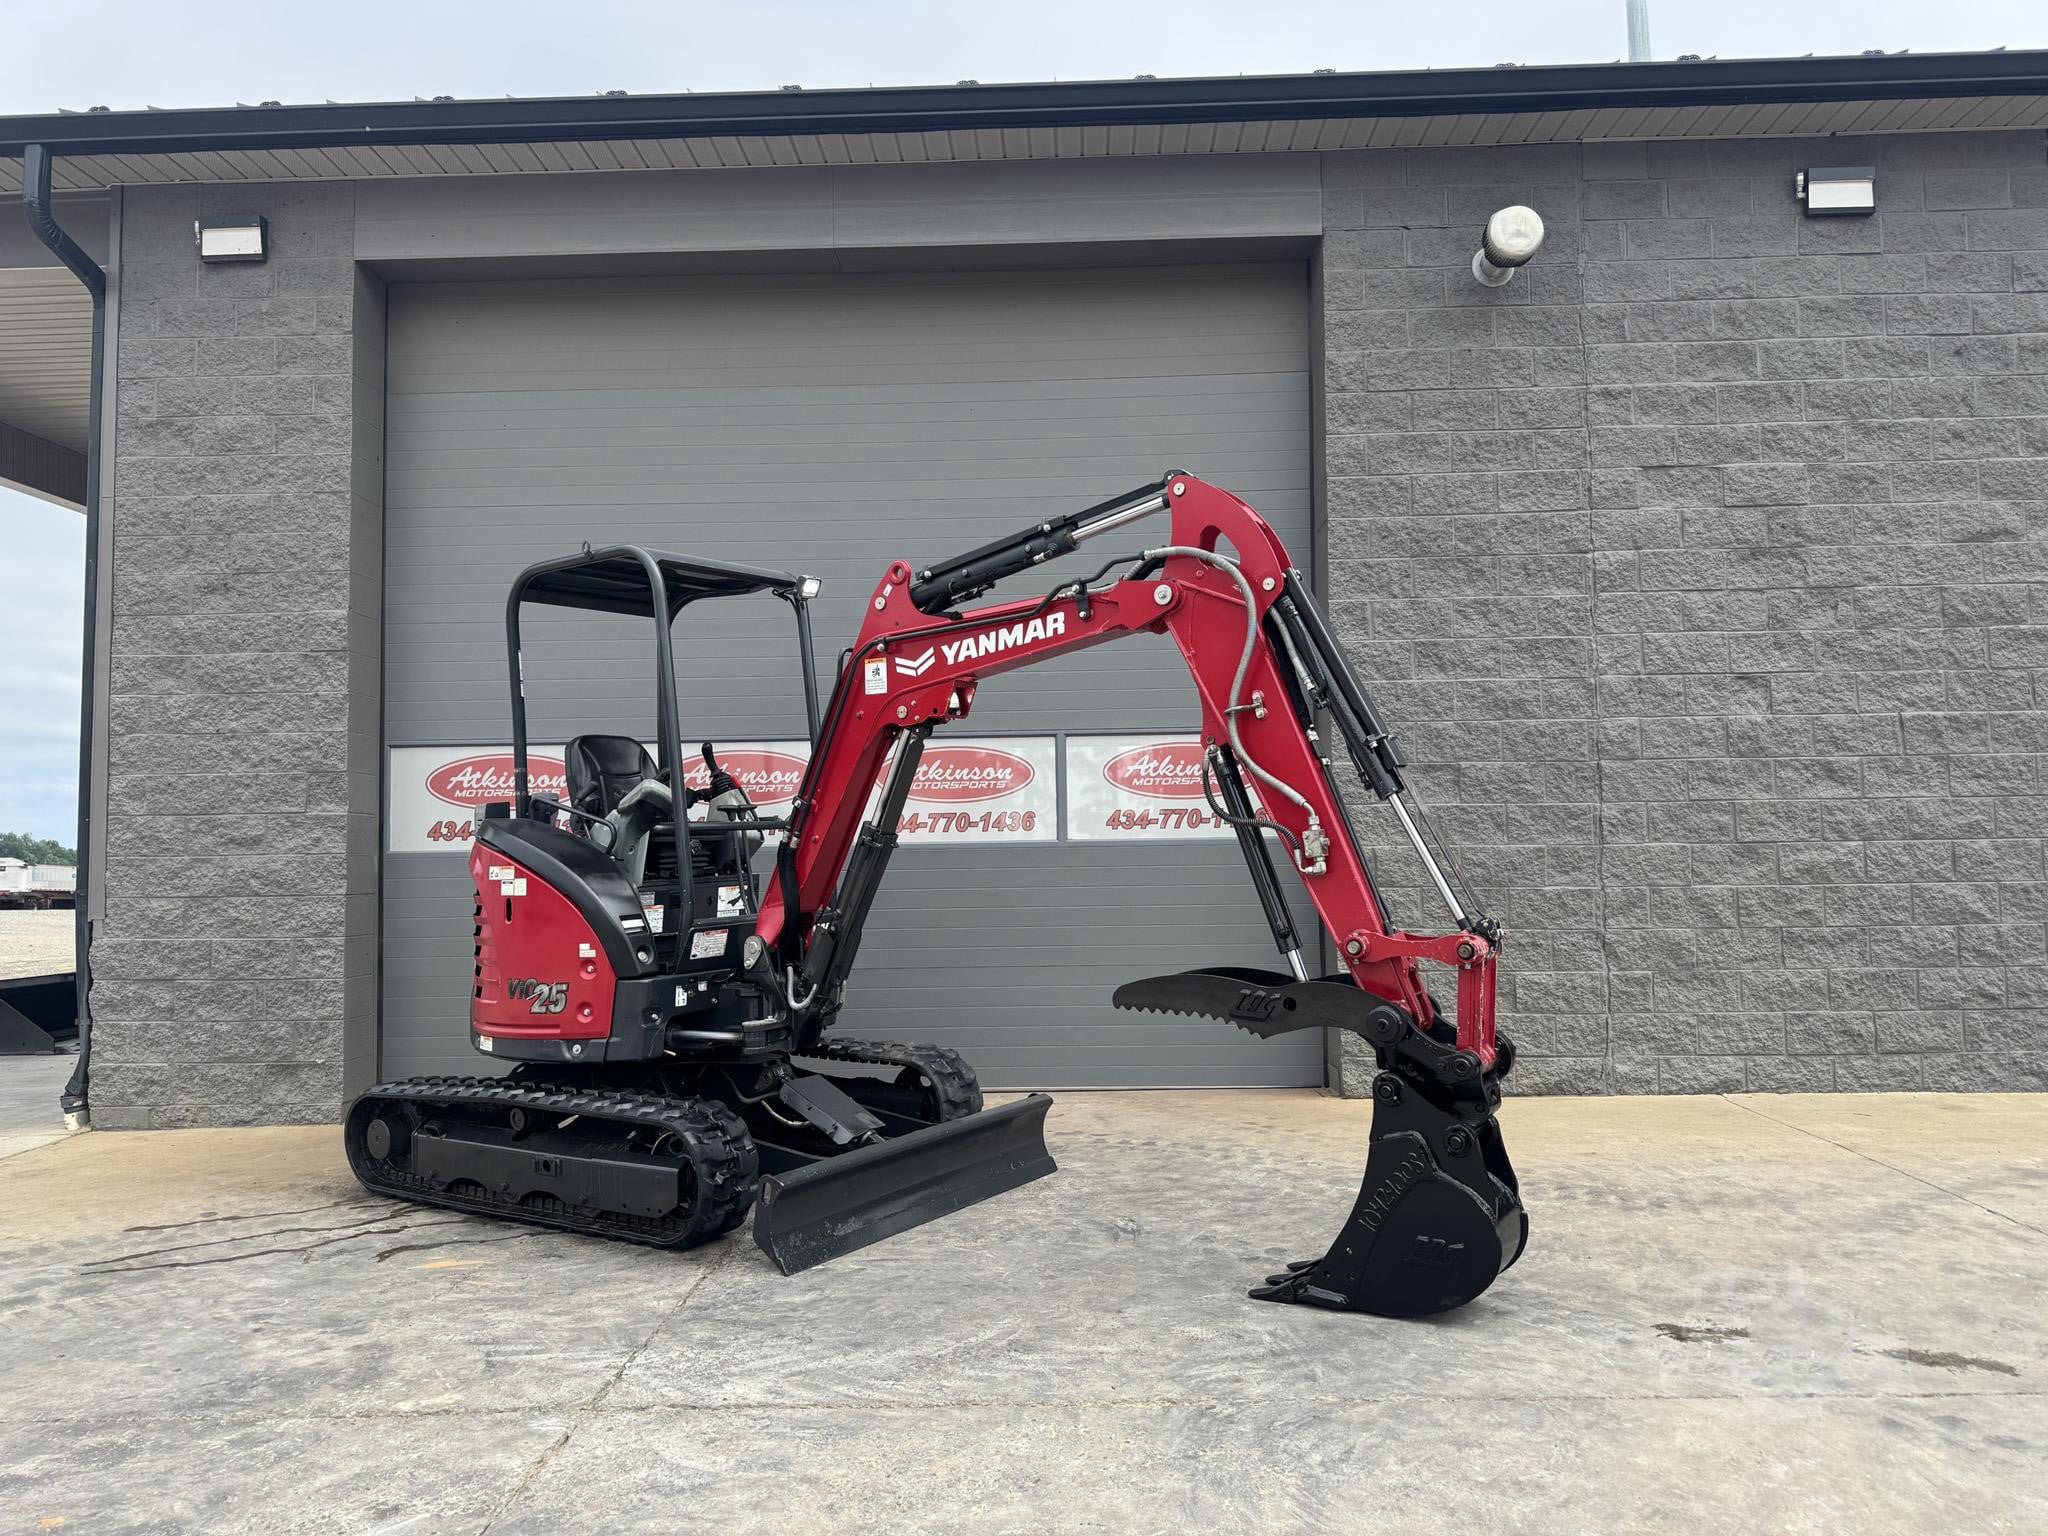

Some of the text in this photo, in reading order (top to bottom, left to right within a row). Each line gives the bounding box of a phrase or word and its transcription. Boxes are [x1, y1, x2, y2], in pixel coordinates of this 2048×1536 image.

[941, 612, 1065, 665] YANMAR
[913, 759, 1013, 780] tkinson
[910, 780, 1007, 790] OTORSPORTS
